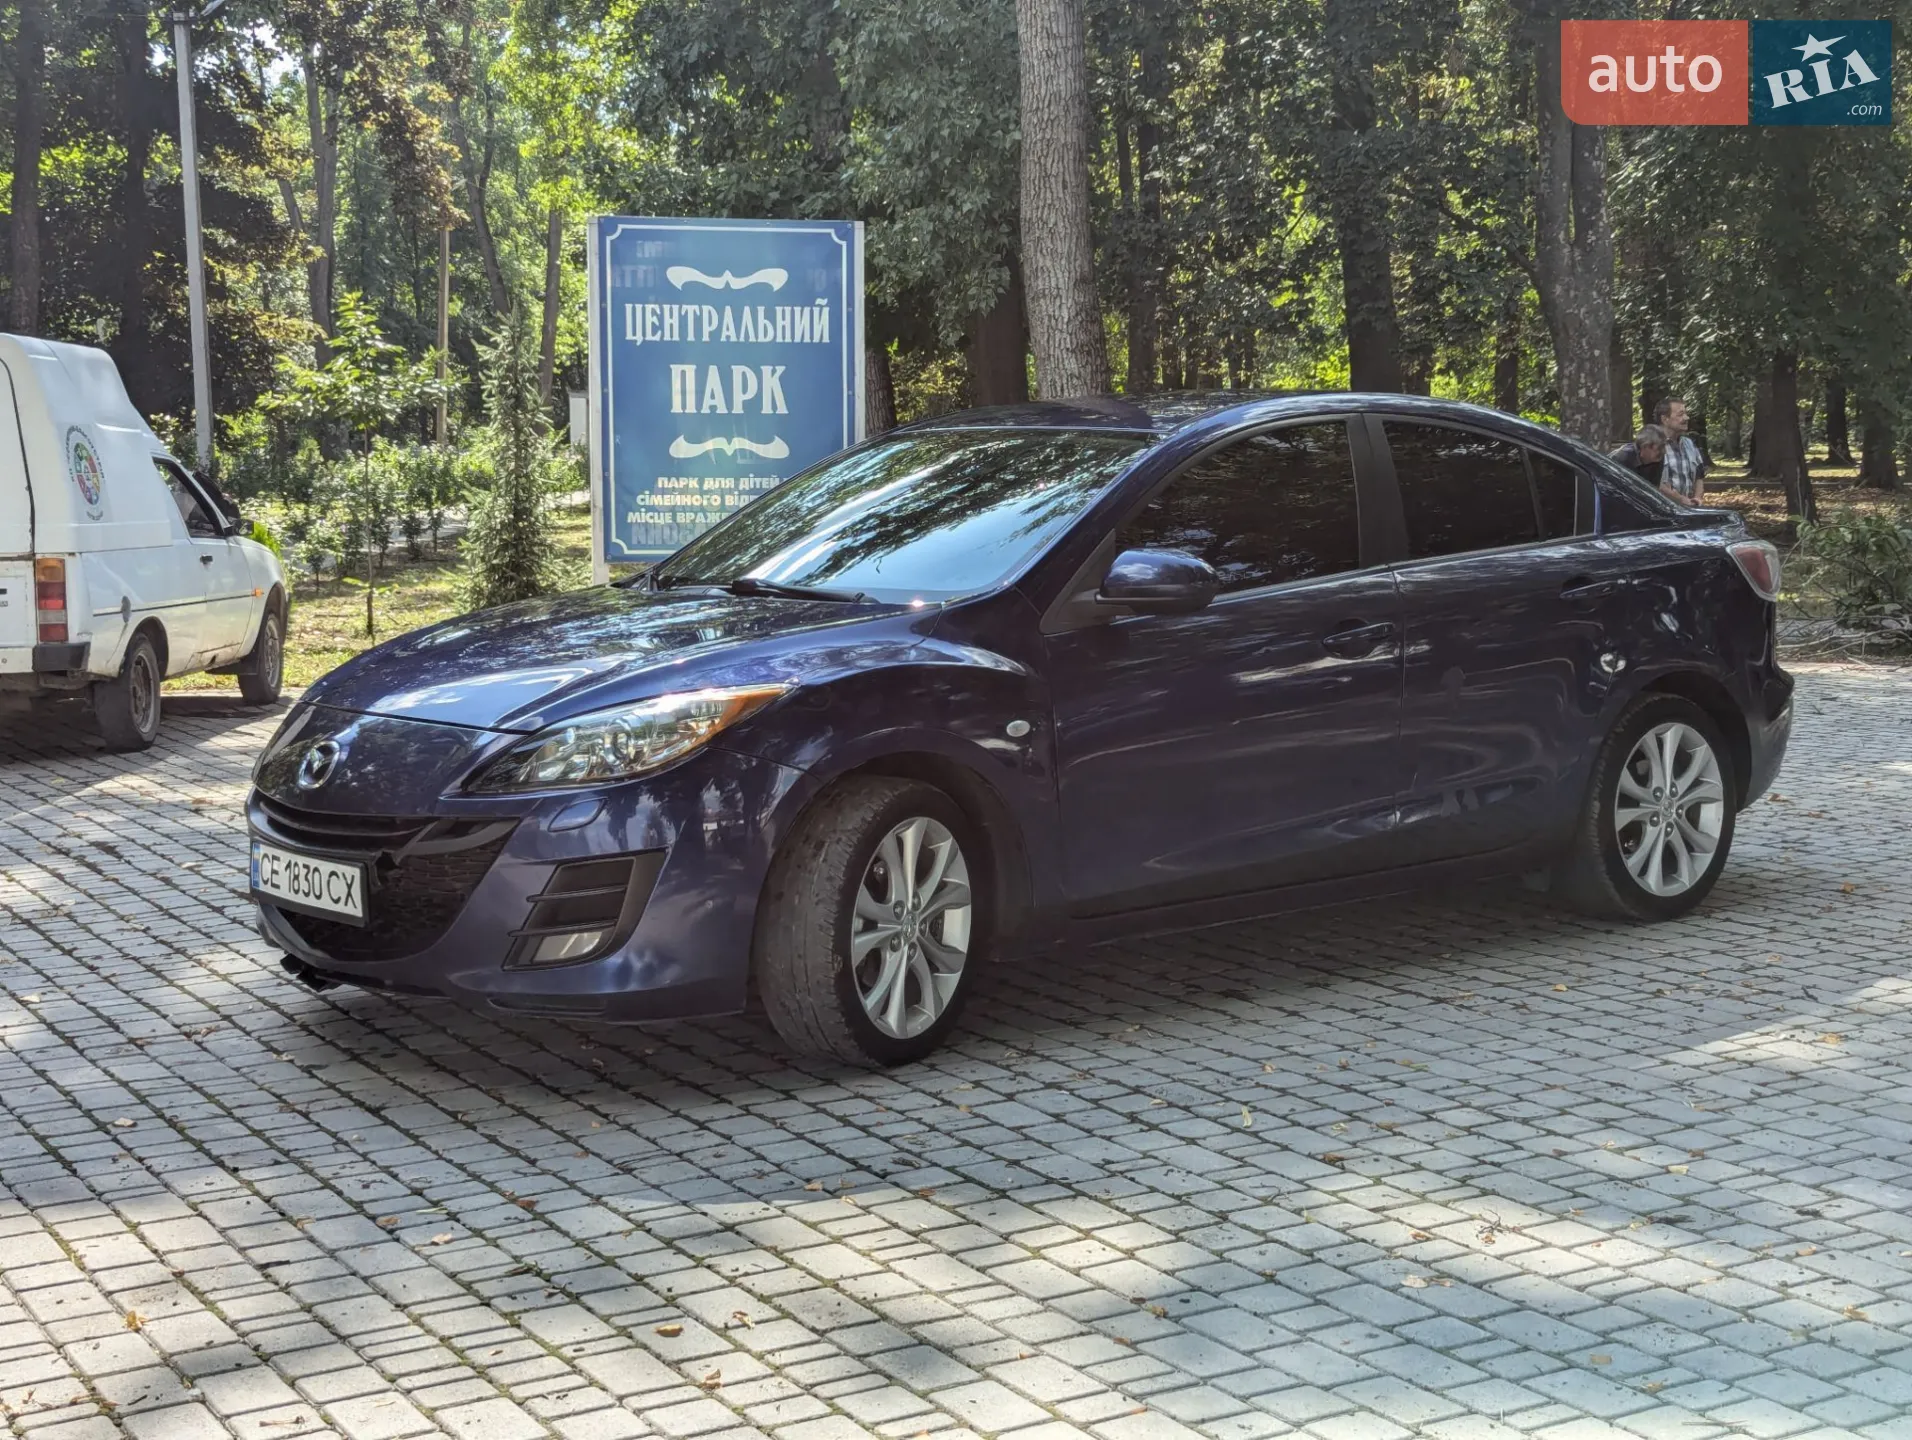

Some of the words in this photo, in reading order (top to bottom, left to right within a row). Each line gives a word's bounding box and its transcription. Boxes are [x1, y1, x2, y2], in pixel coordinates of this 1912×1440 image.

[624, 298, 830, 346] ЦЕНТРАЛЬНИЙ
[670, 364, 789, 414] ПАРК
[657, 476, 699, 489] ПАРК
[703, 477, 735, 490] ДЛЯ
[260, 852, 281, 890] CE
[284, 859, 323, 901] 1830
[327, 870, 358, 909] CX
